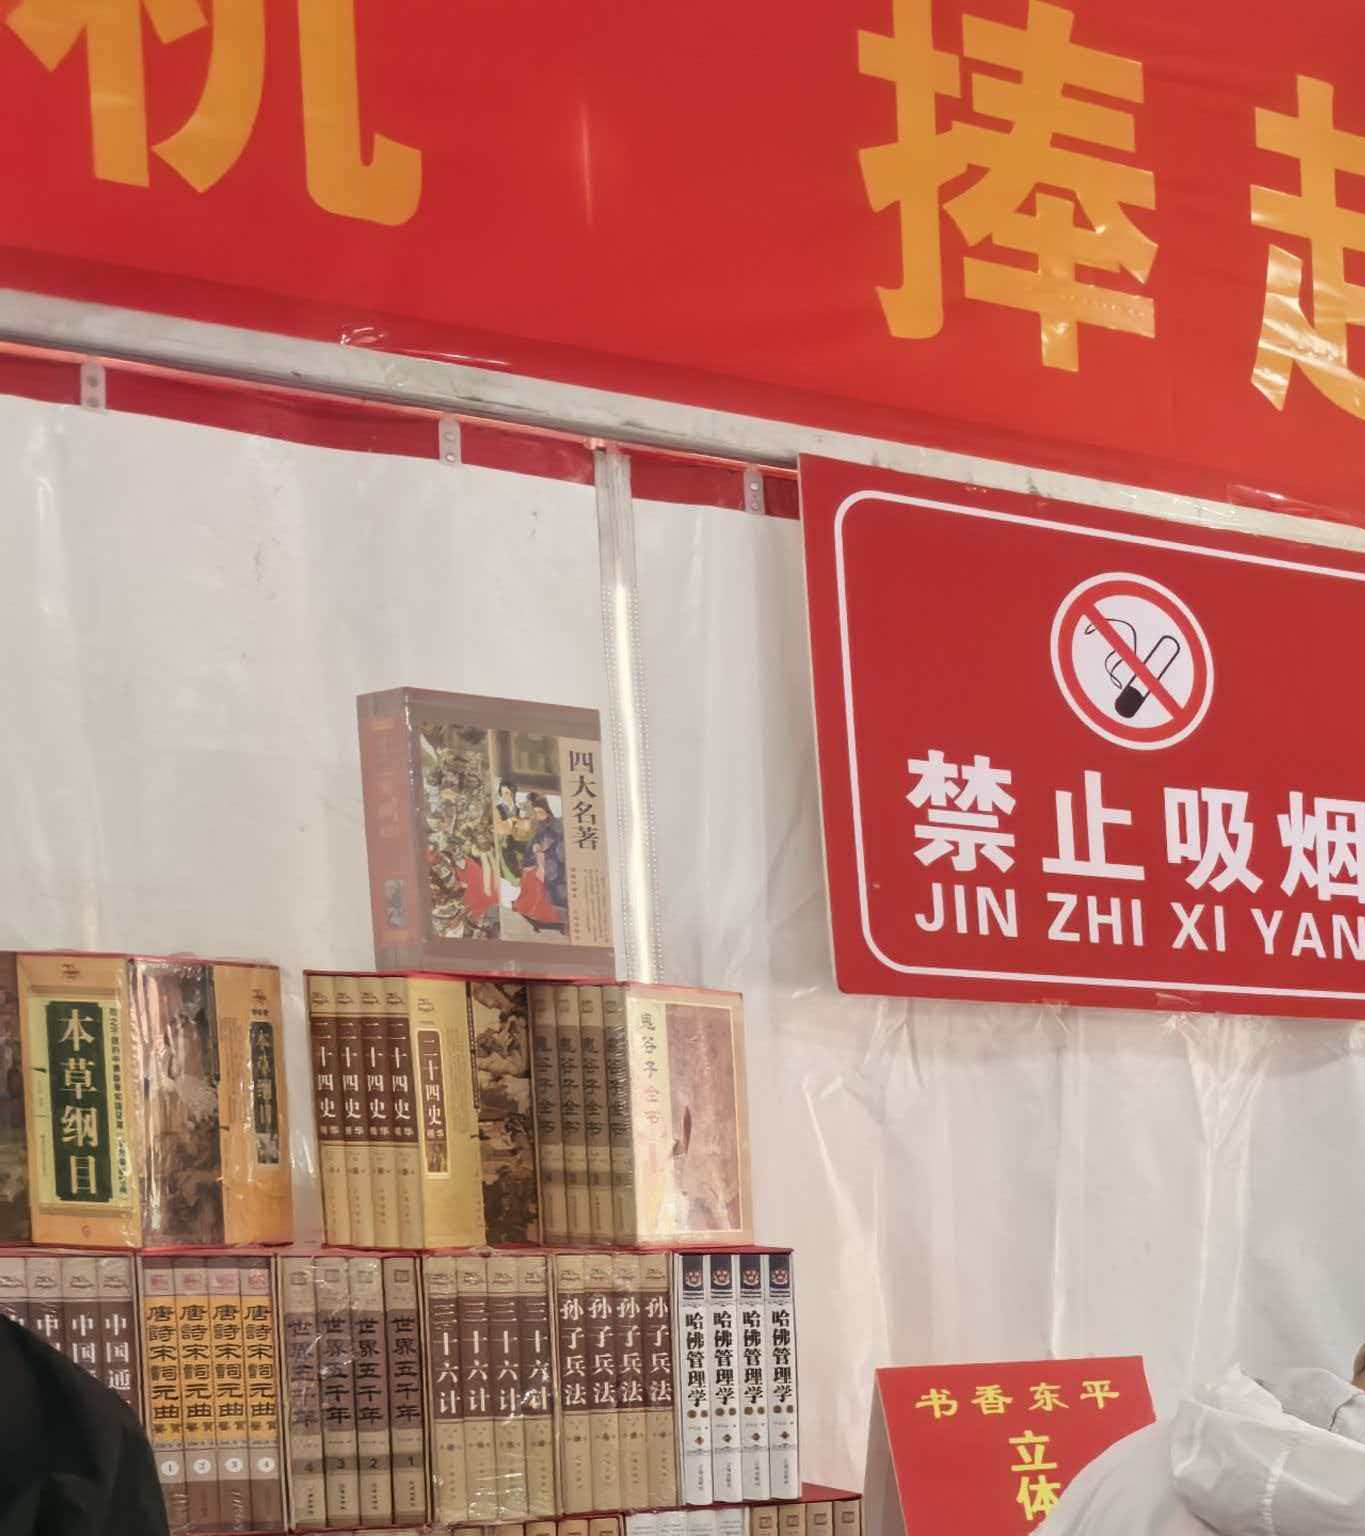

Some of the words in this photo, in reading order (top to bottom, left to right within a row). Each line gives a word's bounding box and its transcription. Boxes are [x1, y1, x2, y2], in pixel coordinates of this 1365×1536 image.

[568, 749, 601, 852] 四大名著
[914, 883, 1019, 939] JIN
[1046, 891, 1145, 948] ZHI
[1171, 901, 1227, 953] XI
[57, 1007, 100, 1196] 本草纲目
[313, 1021, 335, 1119] 二十四史
[338, 1021, 360, 1119] 二十四史
[364, 1021, 386, 1119] 二十四史
[390, 1021, 411, 1119] 二十四史
[423, 1038, 442, 1126] 二十四史
[104, 1313, 133, 1404] 中国通
[321, 1317, 351, 1424] 世界五千年
[355, 1317, 384, 1425] 世界五千年
[391, 1316, 422, 1423] 世界五千年
[433, 1303, 461, 1414] 三十六计
[463, 1302, 491, 1413] 三十六计
[492, 1302, 520, 1412] 三十六计
[560, 1297, 587, 1406] 孙子兵法
[589, 1295, 615, 1404] 孙子兵法
[617, 1296, 643, 1403] 孙子兵法
[645, 1295, 672, 1402] 孙子兵法
[685, 1311, 707, 1408] 哈佛管理学
[712, 1310, 736, 1406] 哈佛管理学
[742, 1309, 764, 1405] 哈佛管理学
[771, 1309, 793, 1404] 哈佛管理学
[914, 1379, 1120, 1419] 书香东平
